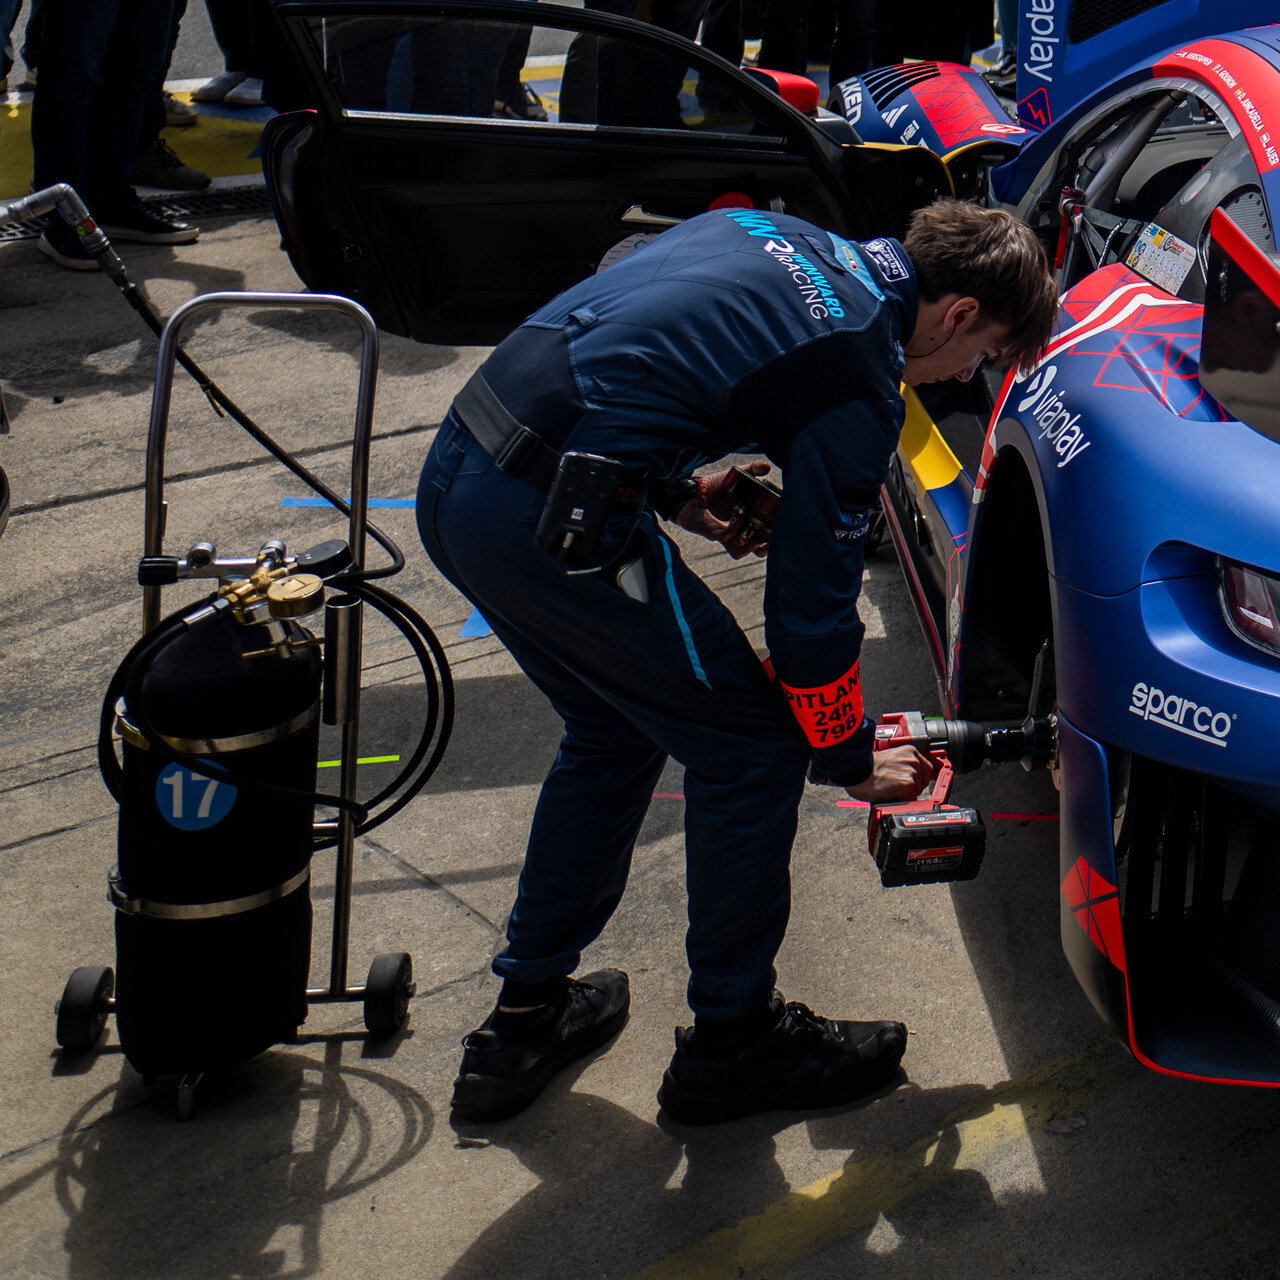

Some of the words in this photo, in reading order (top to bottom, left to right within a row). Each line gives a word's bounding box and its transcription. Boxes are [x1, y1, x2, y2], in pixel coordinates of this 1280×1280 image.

[1241, 98, 1264, 132] JUNCADELLA
[1265, 146, 1280, 166] AUER
[774, 253, 829, 321] RACING
[792, 253, 845, 319] WINWARD
[1033, 388, 1091, 468] viaplay
[813, 702, 854, 727] 24h
[814, 717, 857, 743] 798
[1132, 682, 1232, 739] sparco
[162, 771, 220, 819] 17
